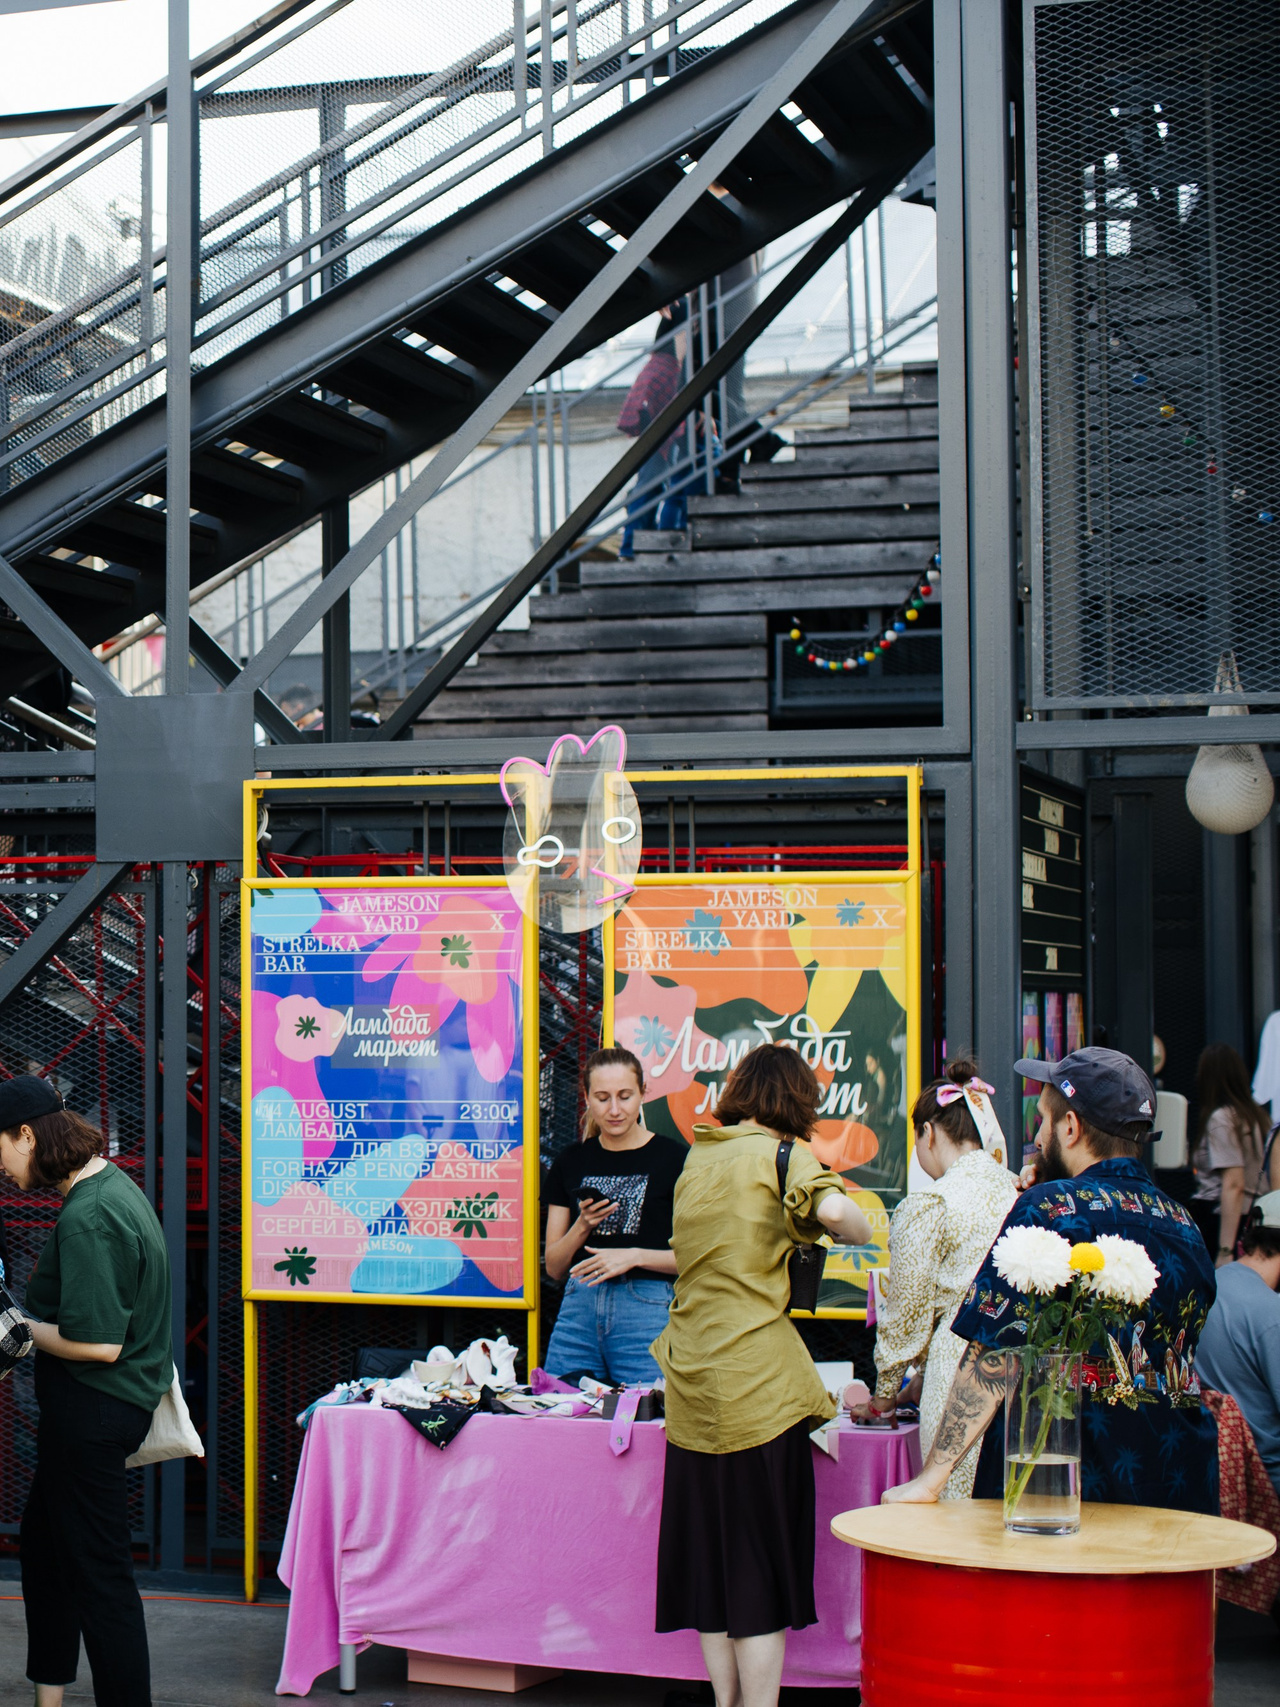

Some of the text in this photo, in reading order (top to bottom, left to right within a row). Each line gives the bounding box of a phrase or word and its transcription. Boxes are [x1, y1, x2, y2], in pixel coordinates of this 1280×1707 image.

[339, 895, 441, 913] JAMESON
[707, 889, 819, 908] JAMESON
[361, 913, 505, 933] YARD X
[731, 909, 889, 929] YARD X
[262, 935, 362, 954] STRELKA
[624, 930, 733, 950] STRELKA
[263, 955, 307, 972] BAR
[625, 951, 673, 970] BAR
[331, 1004, 431, 1039] Ламбада
[353, 1037, 439, 1067] маркет
[289, 1102, 369, 1120] AUGUST
[459, 1103, 512, 1121] 23:00
[261, 1121, 358, 1141] ЛАМБАДА
[350, 1142, 512, 1161] ДЛЯ ВЗРОСЛЫХ
[261, 1161, 500, 1179] FORHAZIS PENOPLASTIK
[261, 1180, 357, 1197] DISKOTEK
[303, 1197, 513, 1219] АЛЕКСЕЙ ХЭЛЛАСИК
[261, 1216, 452, 1239] СЕРГЕЙ БУЛДАКОВ
[355, 1238, 414, 1255] JAMESON
